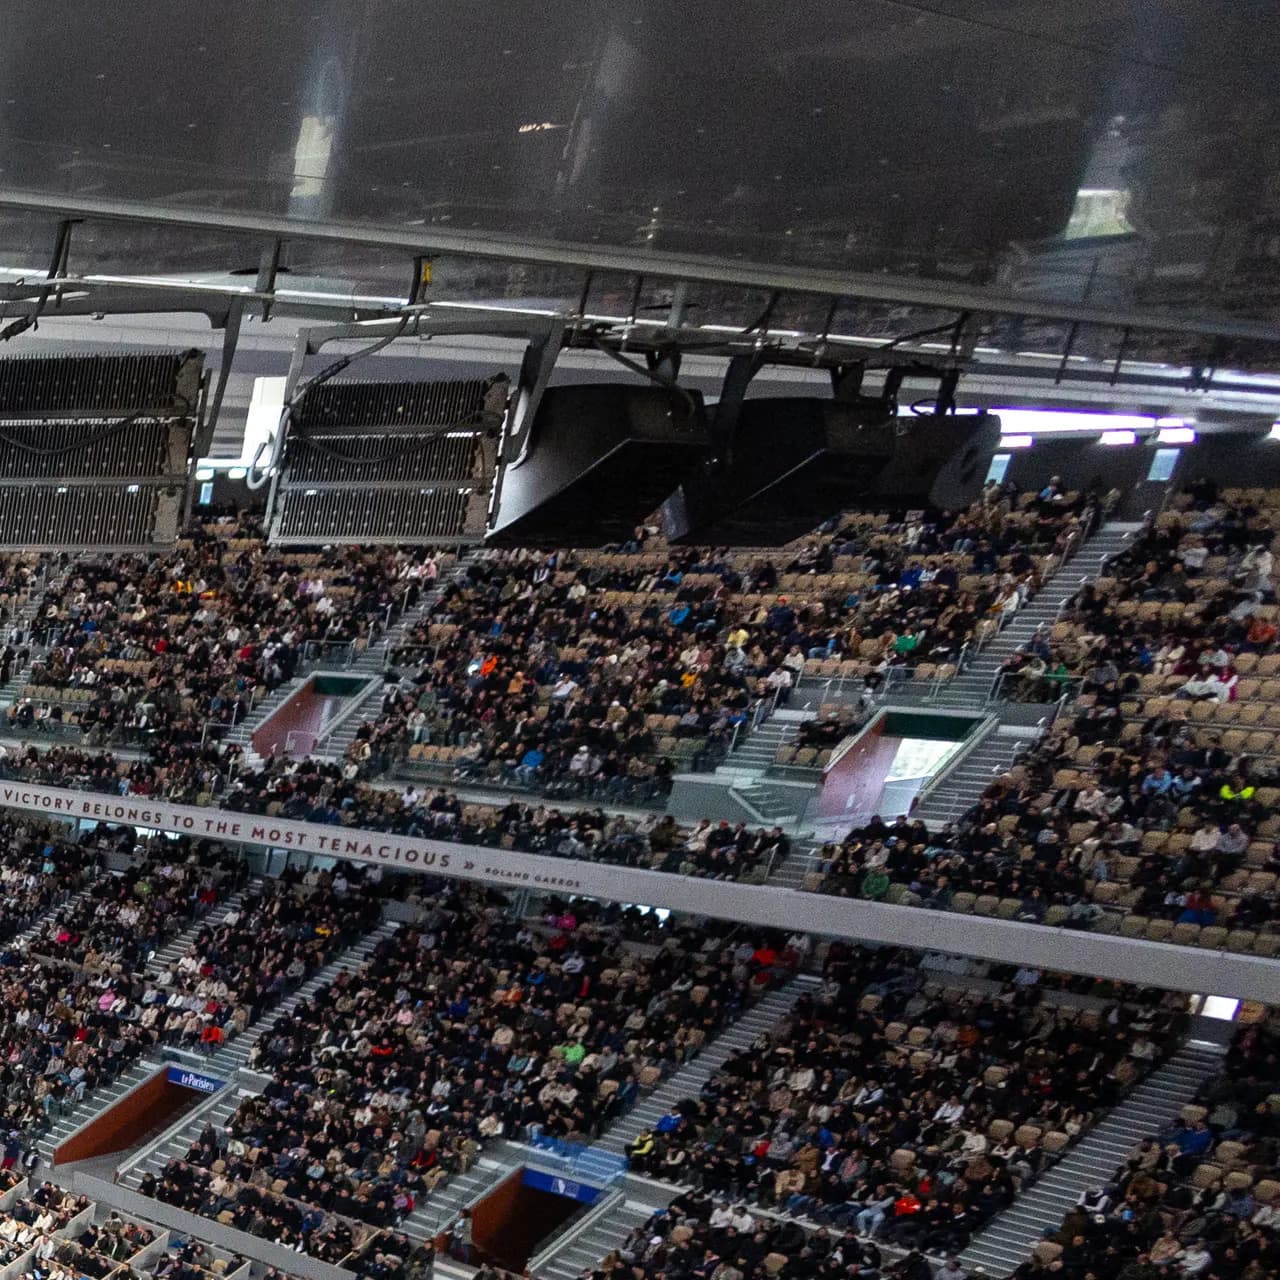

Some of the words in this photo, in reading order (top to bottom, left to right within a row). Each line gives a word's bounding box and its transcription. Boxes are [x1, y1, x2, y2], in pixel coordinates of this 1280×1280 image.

[4, 789, 74, 811] VICTORY
[82, 803, 162, 824] BELONGS
[172, 815, 194, 828] TO
[205, 819, 241, 836] THE
[251, 827, 307, 846] MOST
[318, 836, 451, 868] TENACIOUS
